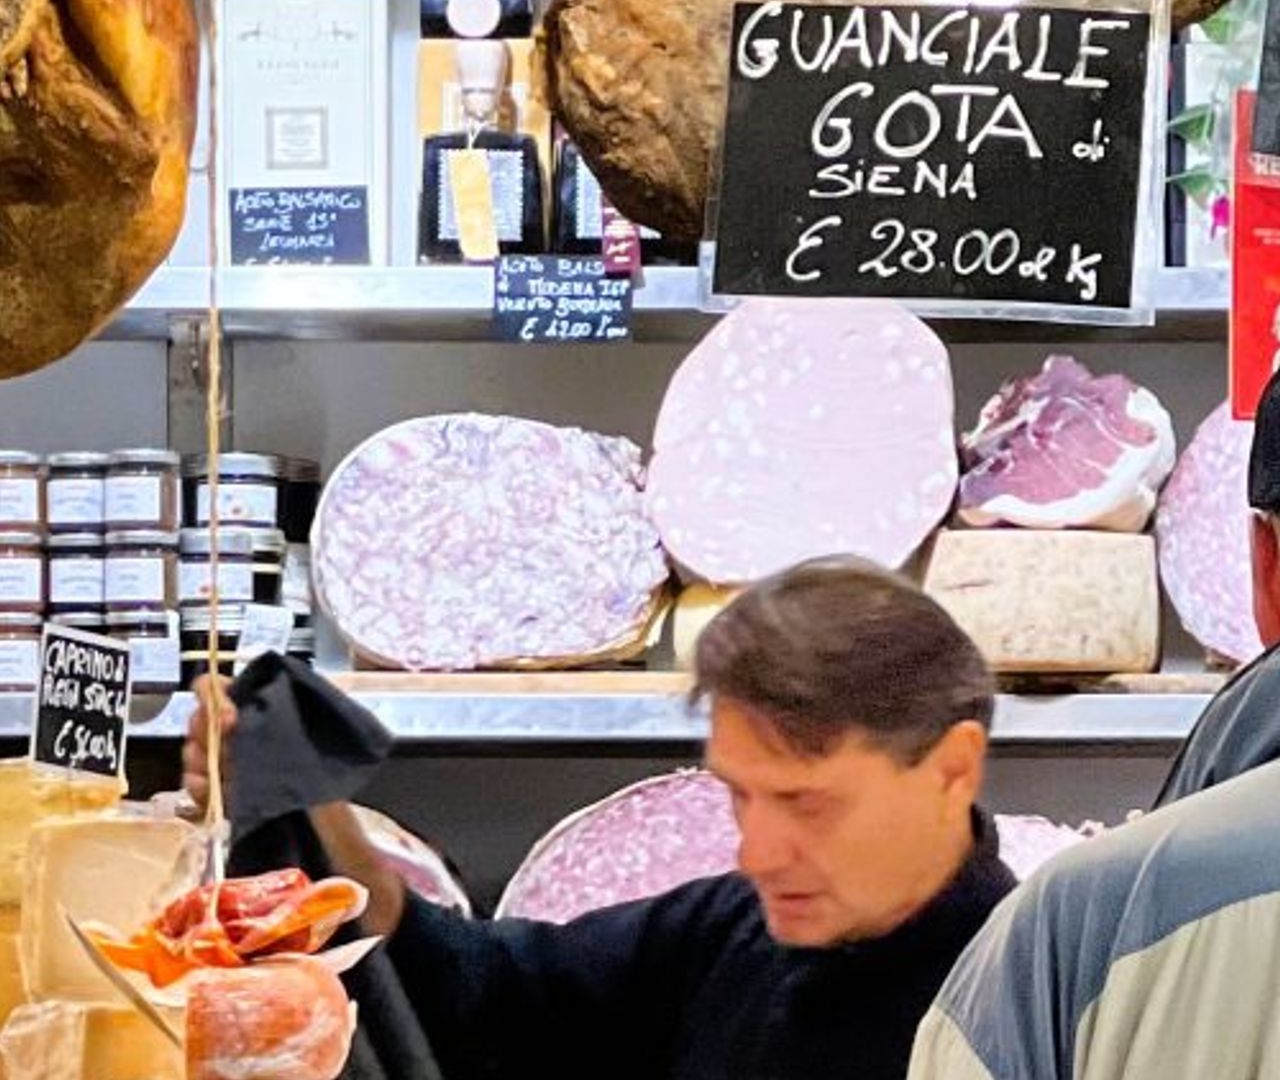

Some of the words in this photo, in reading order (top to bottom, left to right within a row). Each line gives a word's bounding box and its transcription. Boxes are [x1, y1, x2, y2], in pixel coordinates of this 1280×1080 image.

[737, 1, 1131, 88] GUANCIALE
[811, 81, 1043, 159] GOTA
[1071, 119, 1111, 162] di
[785, 216, 842, 282] €
[858, 219, 1021, 278] 28.00
[1066, 243, 1102, 300] Kg
